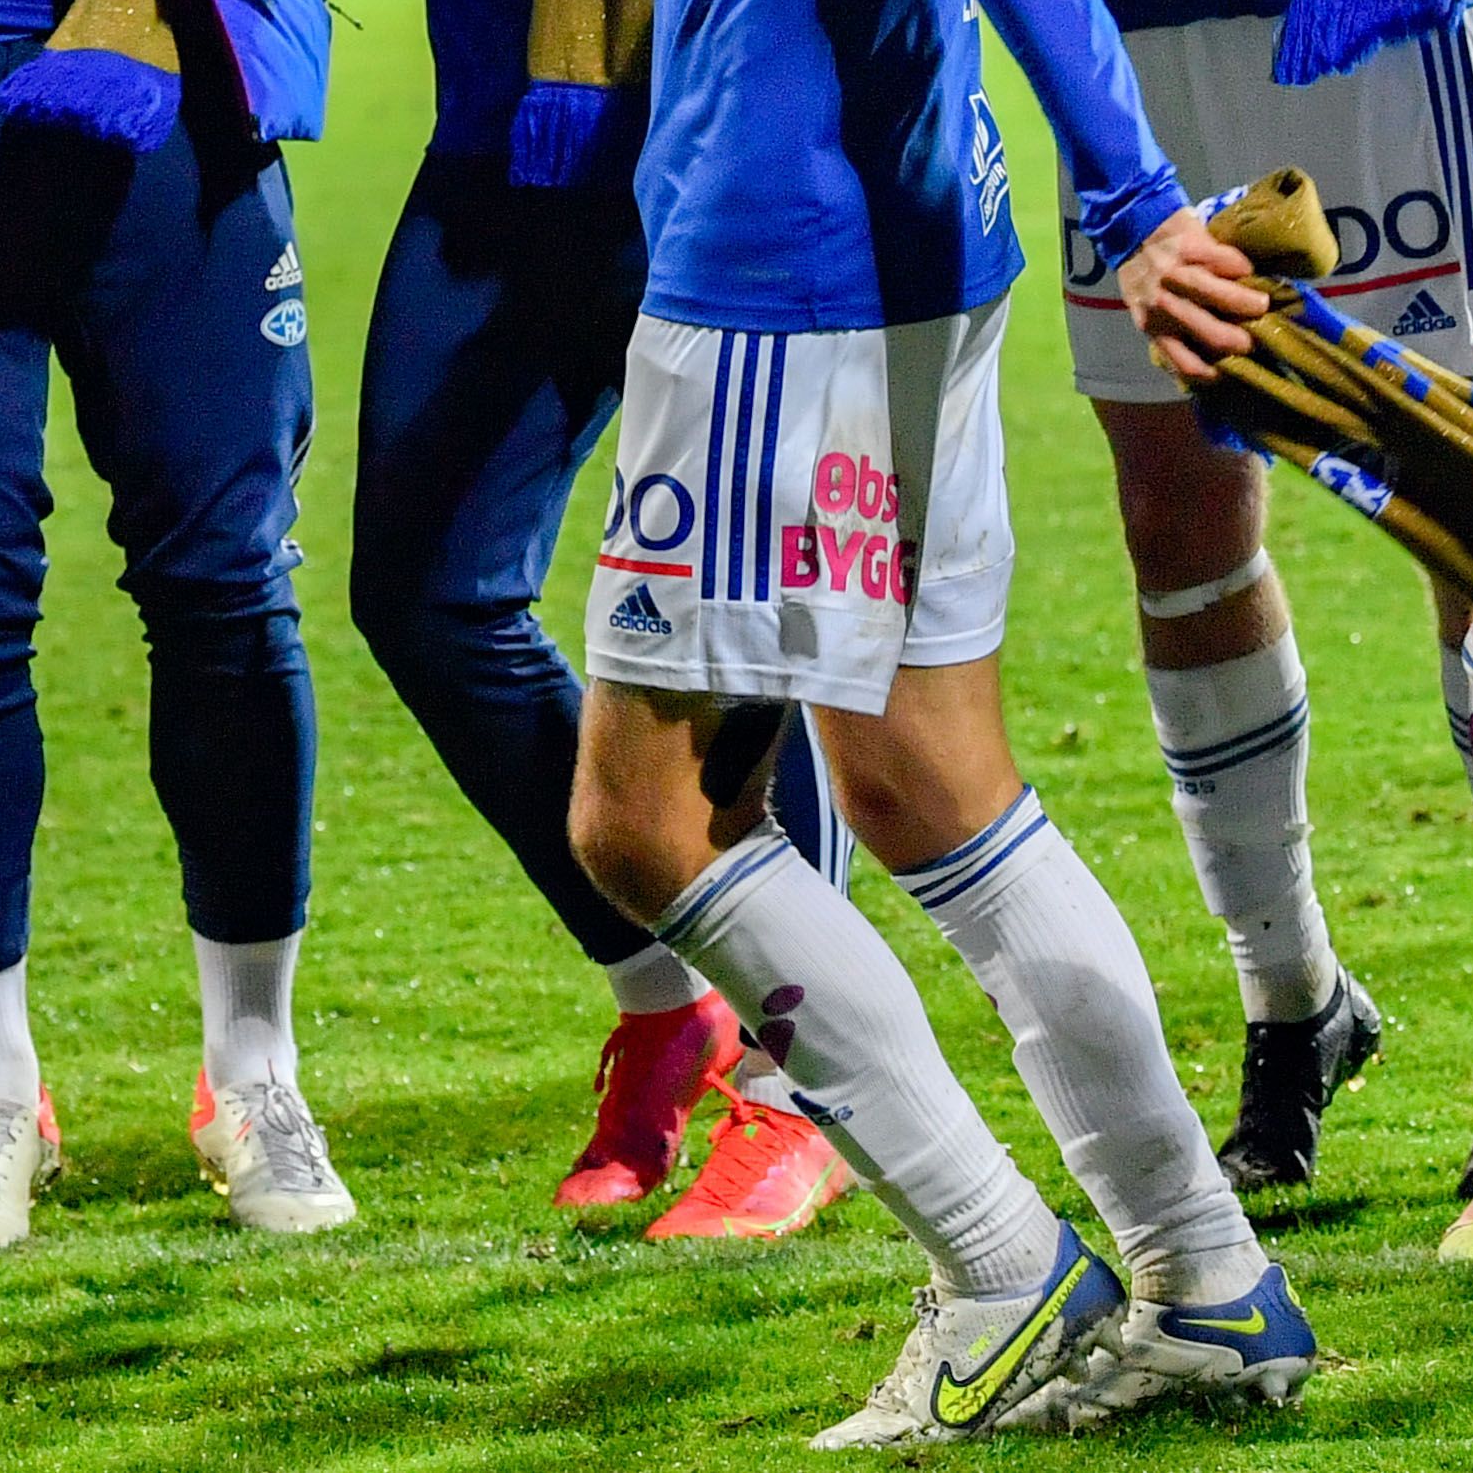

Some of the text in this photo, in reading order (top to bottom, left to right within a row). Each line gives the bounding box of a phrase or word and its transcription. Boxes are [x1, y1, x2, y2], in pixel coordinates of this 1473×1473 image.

[1324, 189, 1451, 277] DO
[1393, 314, 1458, 338] adidas
[780, 524, 916, 606] BYGG
[608, 611, 674, 637] adidas
